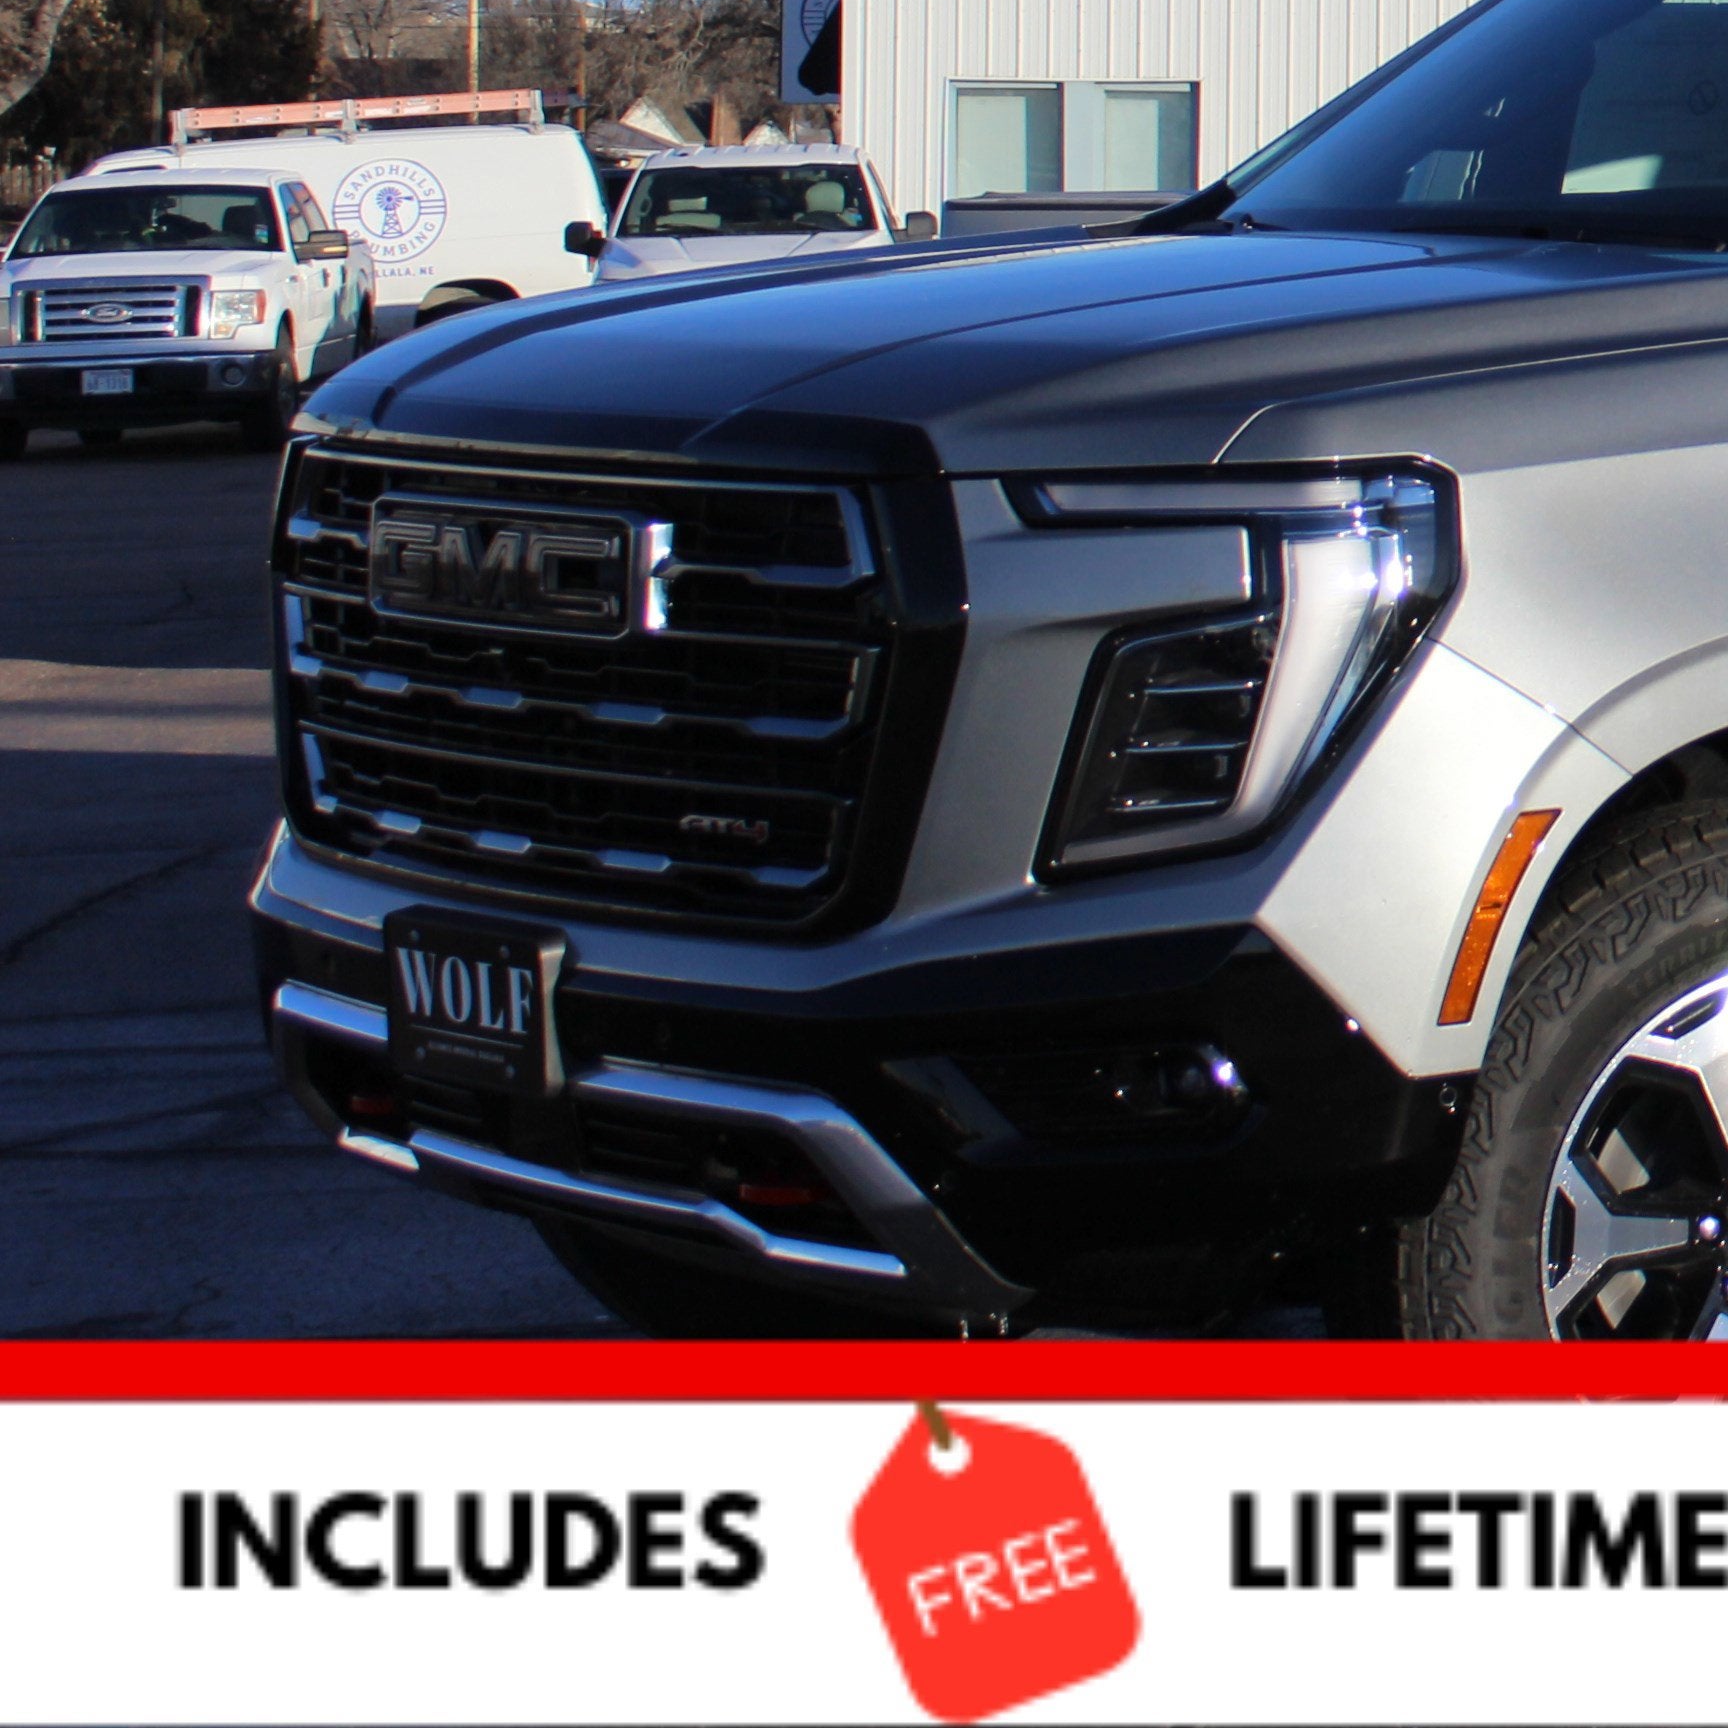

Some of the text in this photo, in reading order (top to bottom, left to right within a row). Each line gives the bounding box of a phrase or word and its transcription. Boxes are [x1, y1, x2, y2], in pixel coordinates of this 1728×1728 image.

[344, 164, 436, 201] SANDHILLS
[347, 220, 436, 257] PUMBING
[420, 265, 435, 276] NE
[373, 521, 621, 619] GMC
[396, 946, 534, 1036] WOLF
